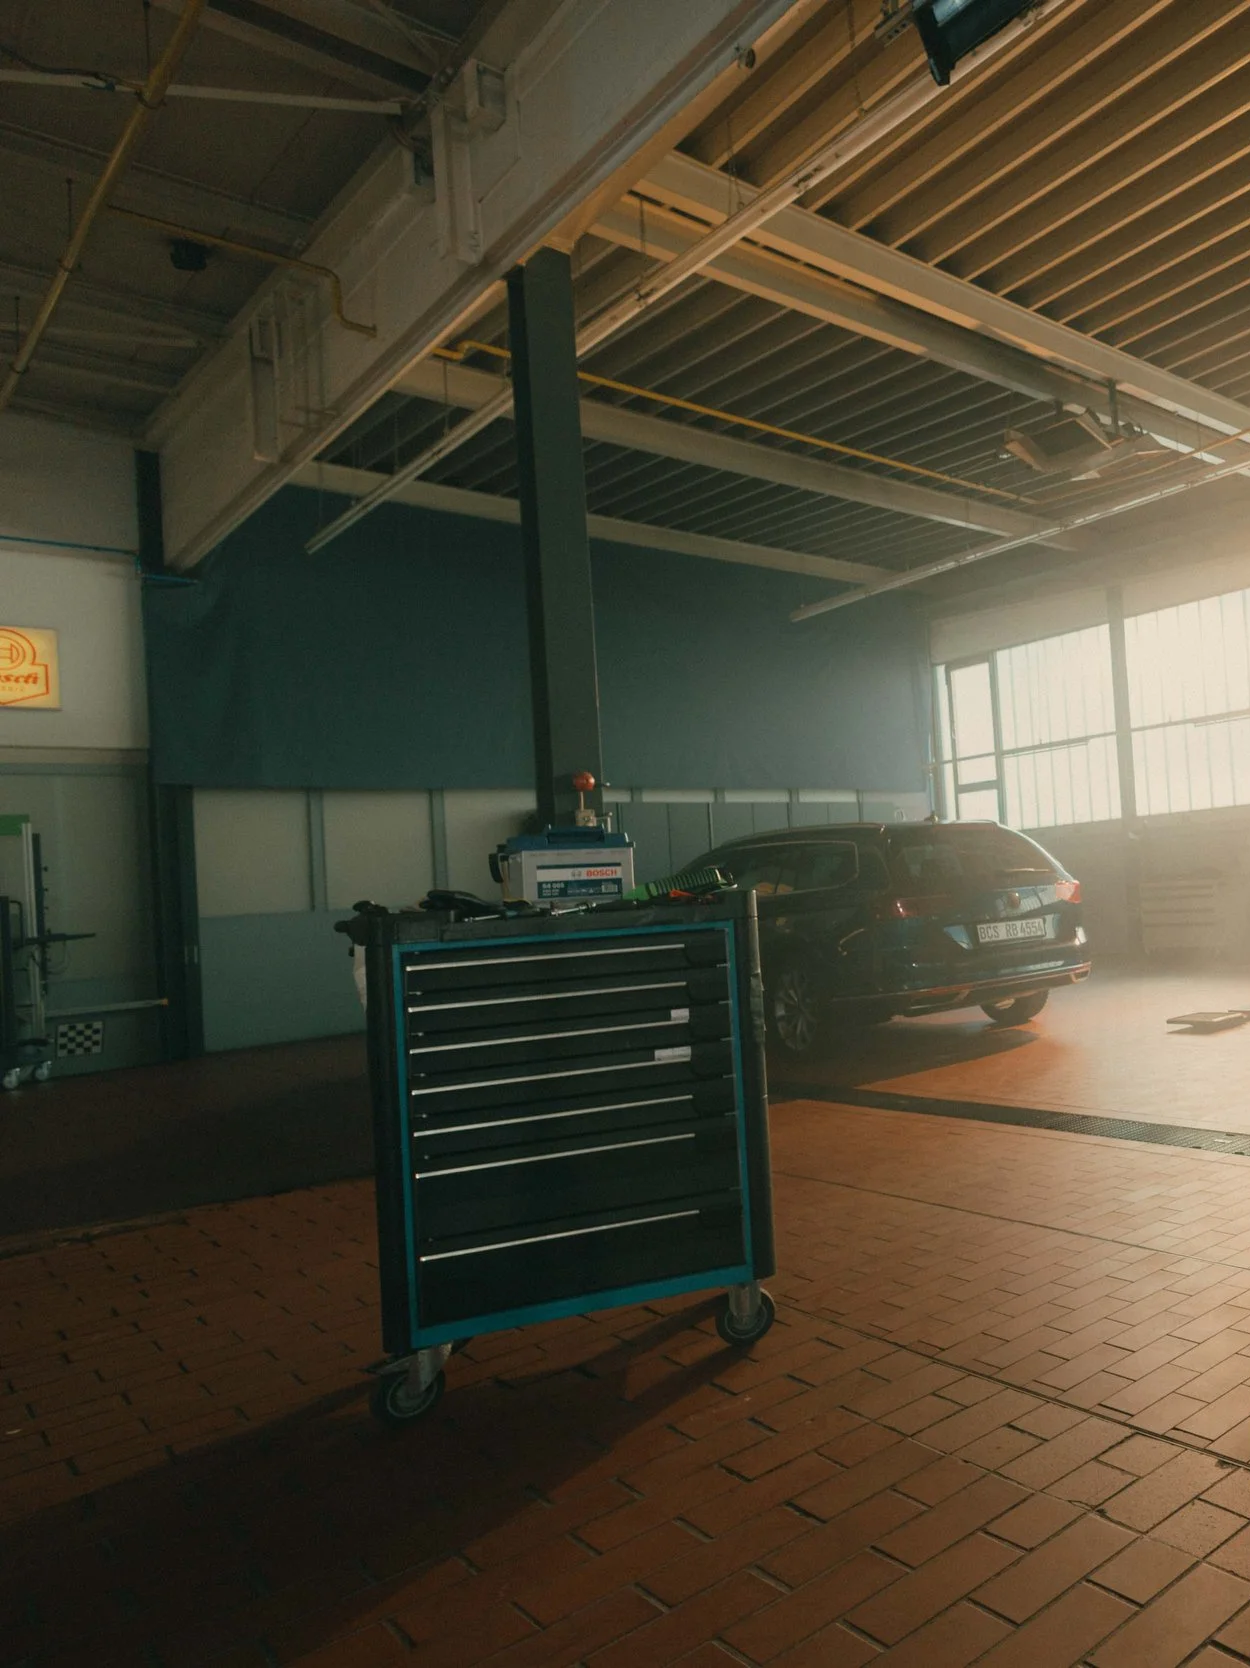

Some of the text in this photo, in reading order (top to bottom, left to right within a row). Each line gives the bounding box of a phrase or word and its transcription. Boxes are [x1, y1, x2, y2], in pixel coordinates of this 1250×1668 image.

[586, 868, 617, 877] BOSCH
[979, 925, 1000, 940] BCS
[1005, 923, 1018, 937] RB
